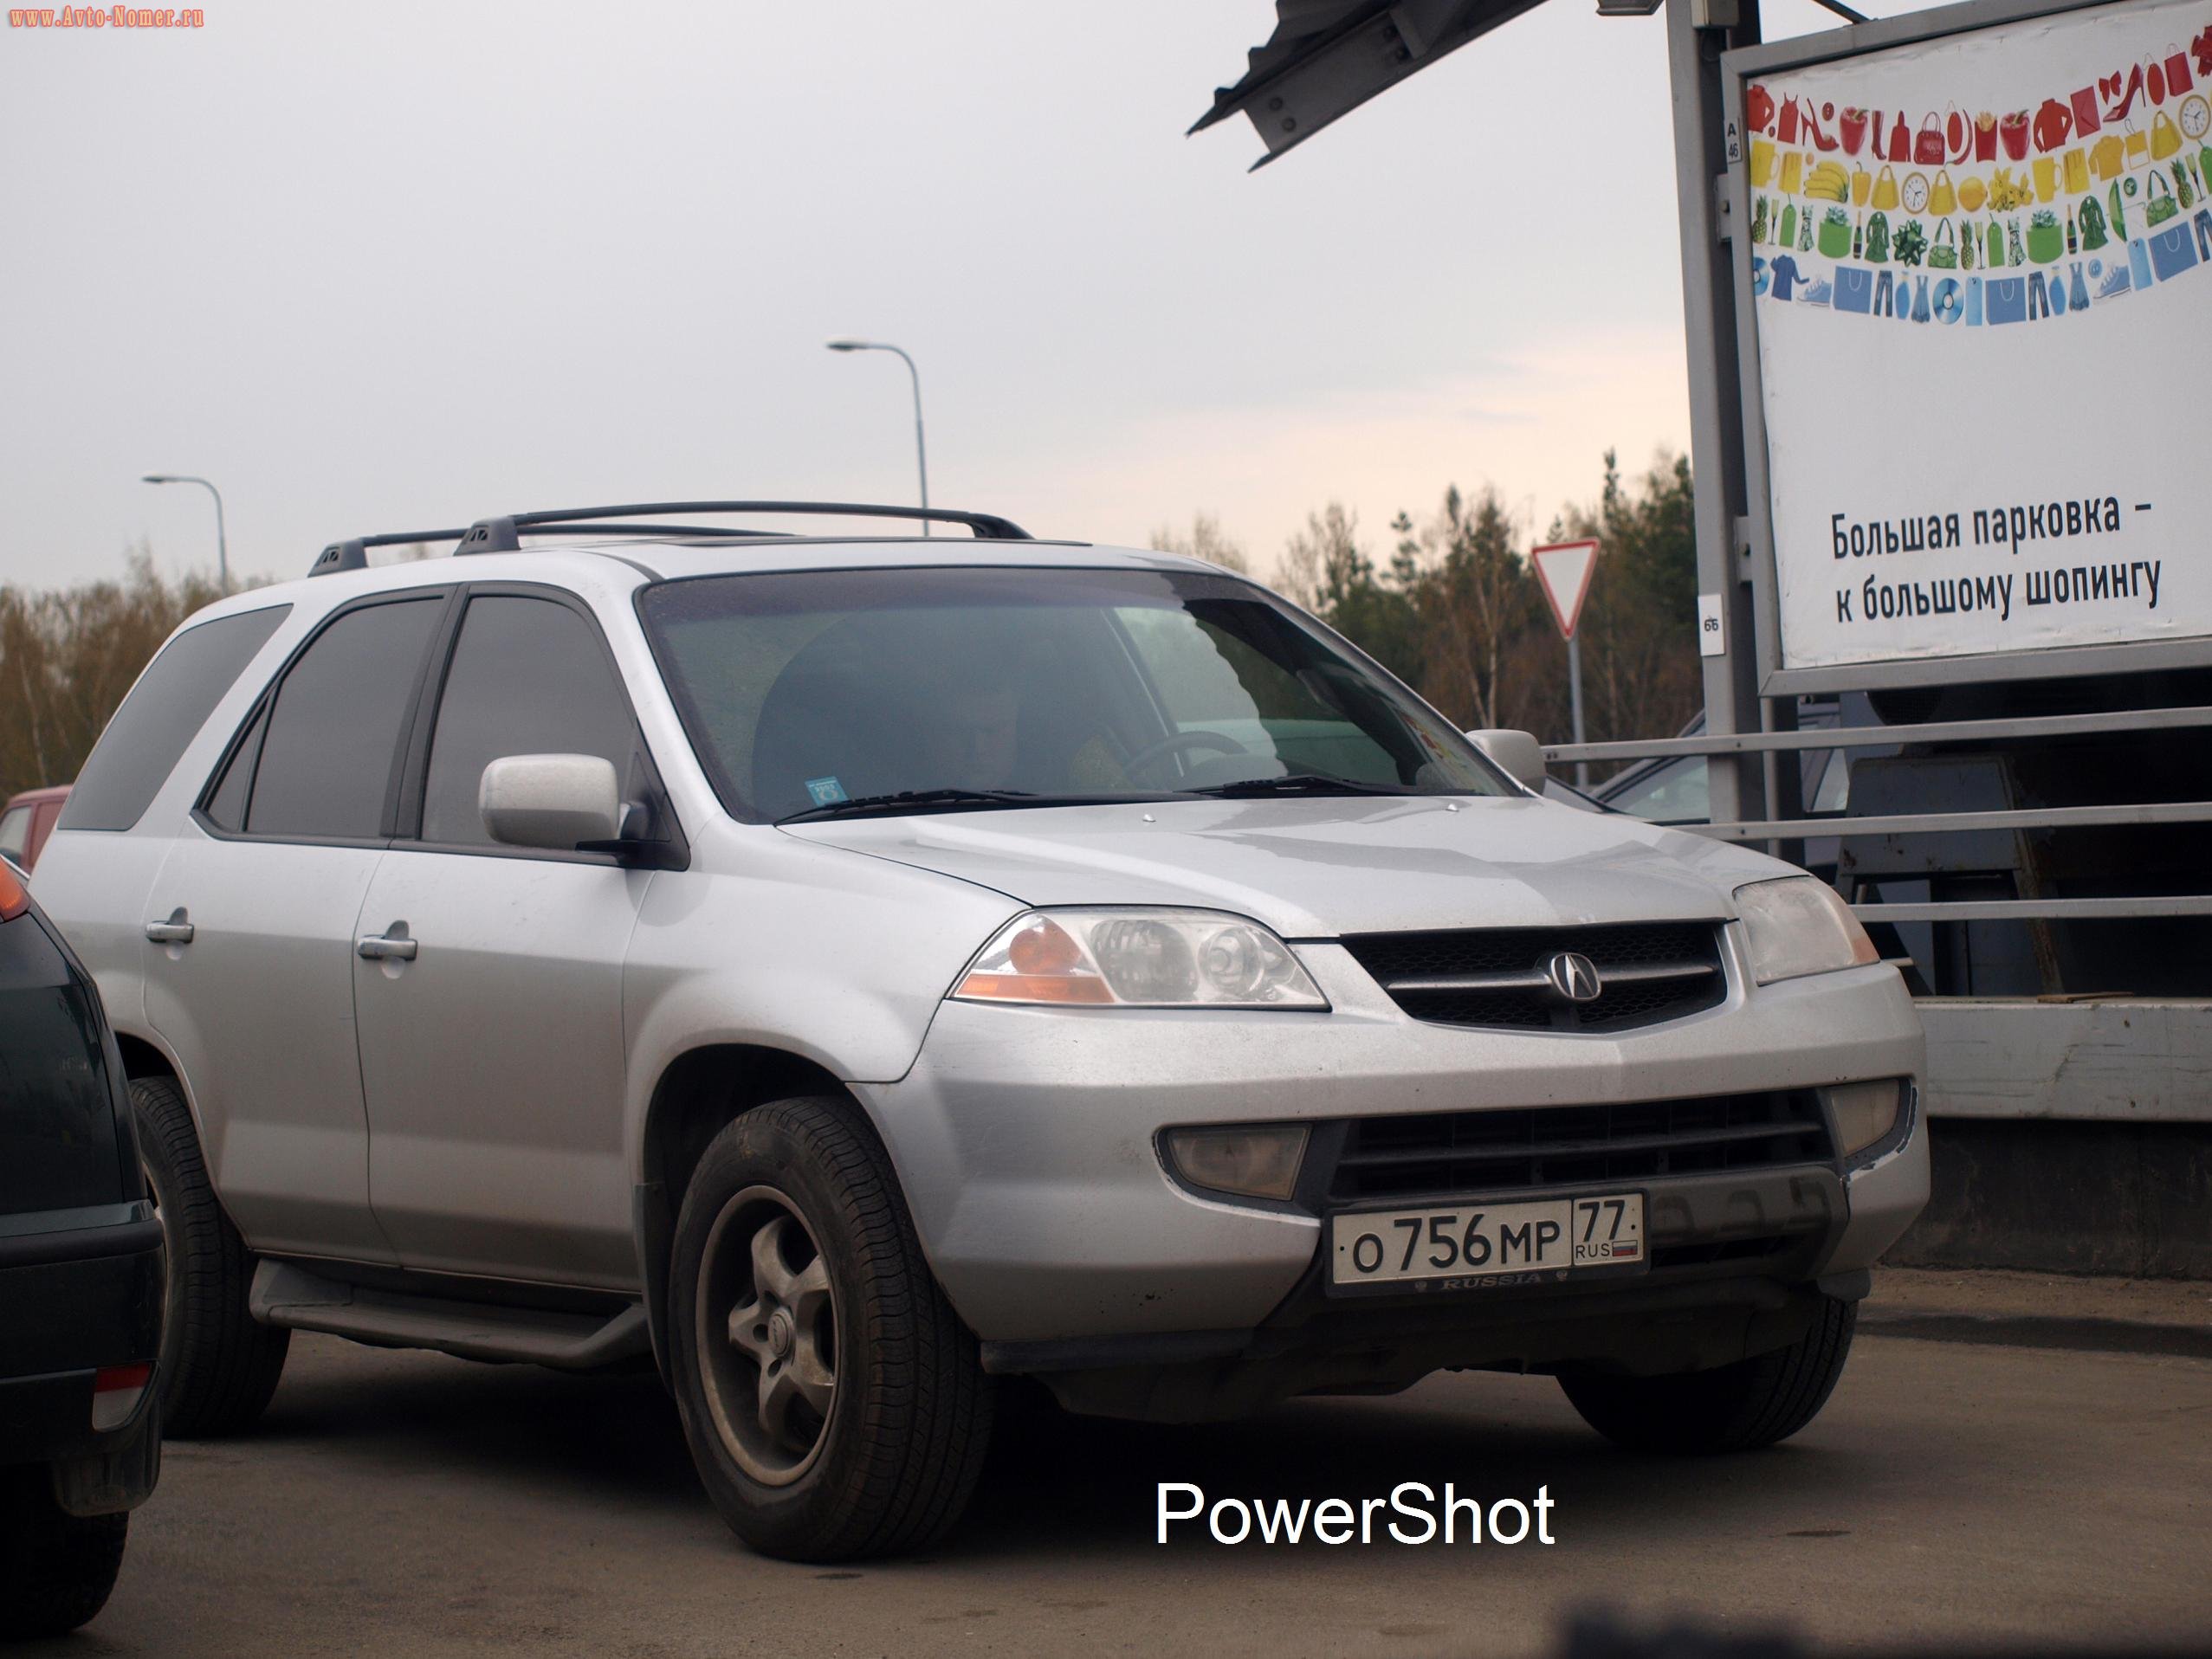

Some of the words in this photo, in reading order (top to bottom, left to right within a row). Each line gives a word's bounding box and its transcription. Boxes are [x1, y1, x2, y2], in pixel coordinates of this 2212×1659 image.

[1728, 142, 1739, 158] 46
[1832, 513, 1960, 559] Большая
[1973, 496, 2120, 555] парковка
[1836, 589, 1853, 623] к
[1863, 574, 2013, 622] большому
[2026, 560, 2161, 610] шопингу
[1578, 1199, 1626, 1243] 77
[1575, 1243, 1610, 1260] RUS
[1440, 1272, 1542, 1291] RUSSIA
